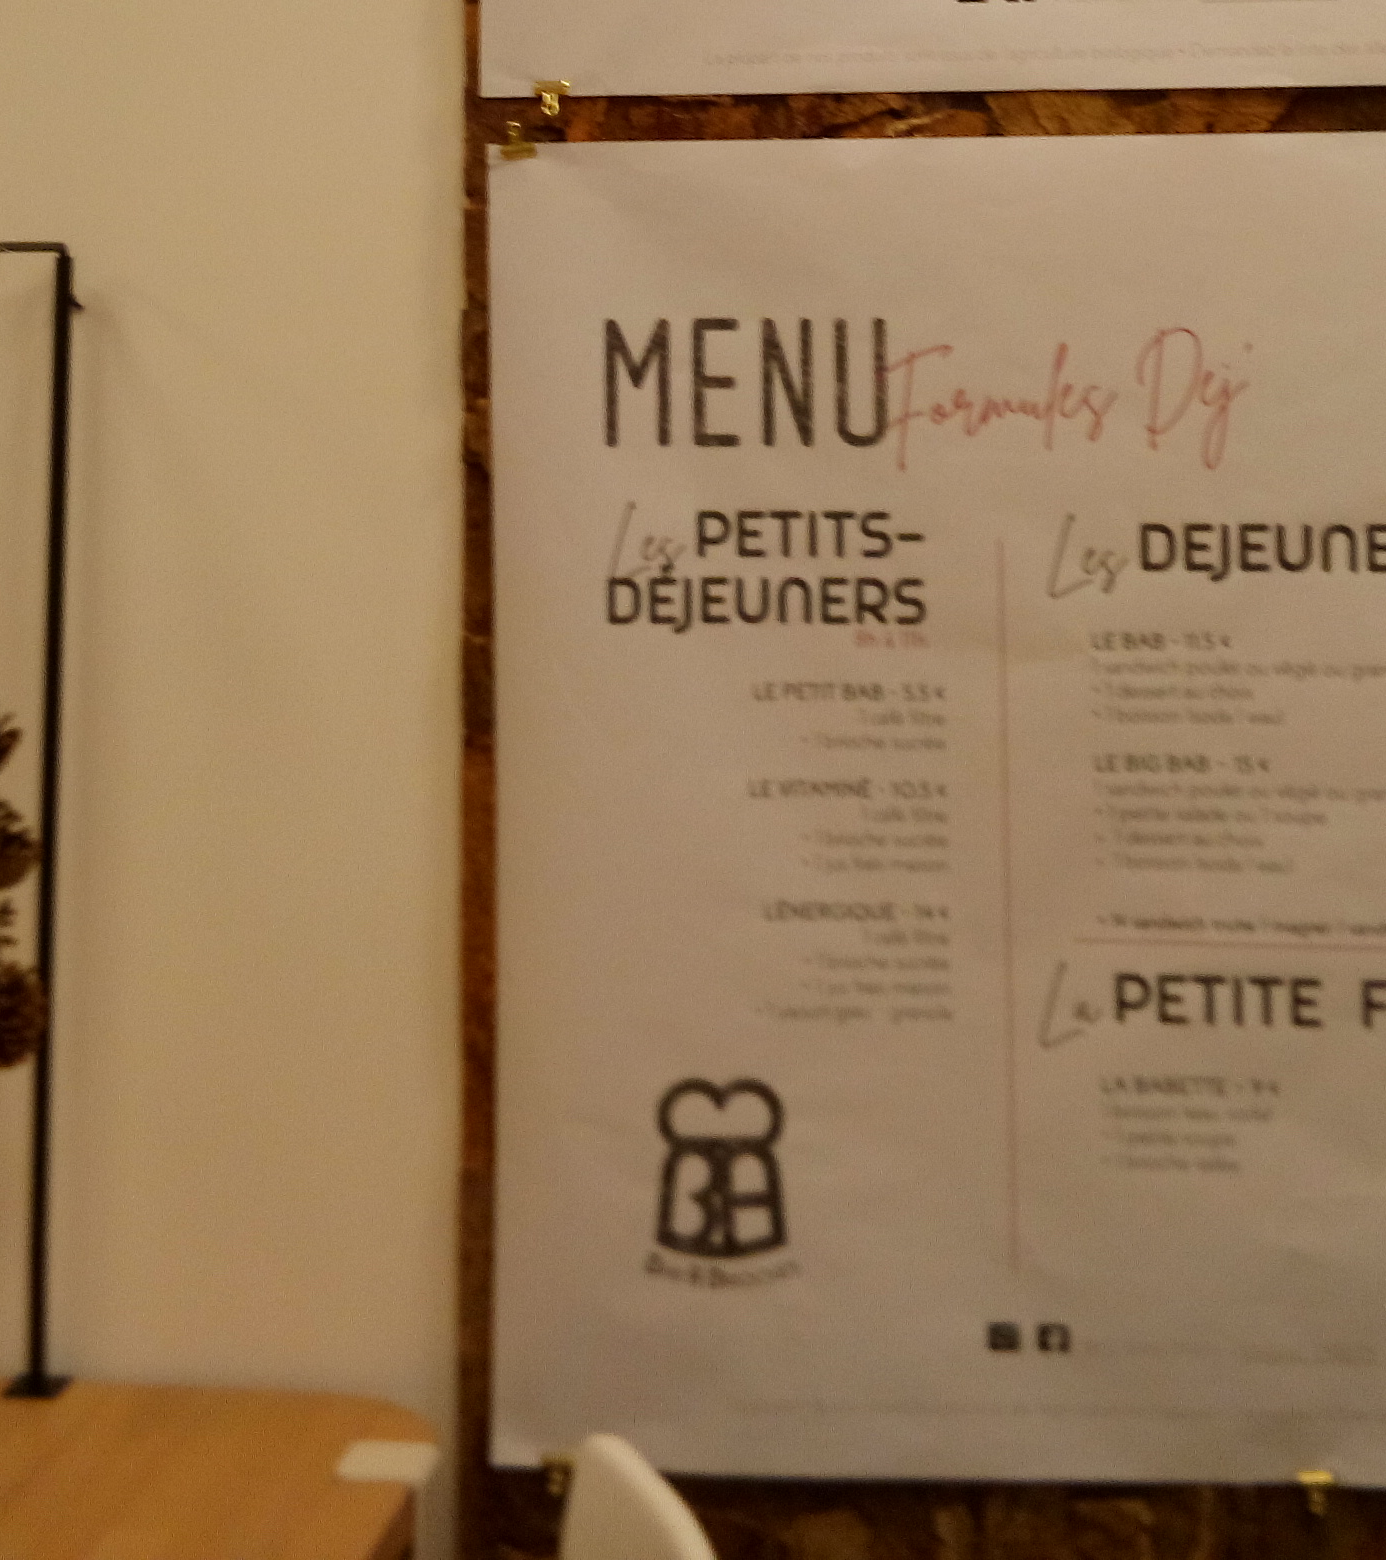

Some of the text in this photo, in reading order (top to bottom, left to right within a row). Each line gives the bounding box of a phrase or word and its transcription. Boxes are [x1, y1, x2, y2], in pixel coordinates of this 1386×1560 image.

[603, 316, 889, 447] MENU
[877, 343, 1119, 472] Formules
[609, 501, 686, 579] Les
[1048, 513, 1130, 598] Les
[607, 565, 927, 634] DÉJEUNERS
[1114, 972, 1323, 1027] PETITE
